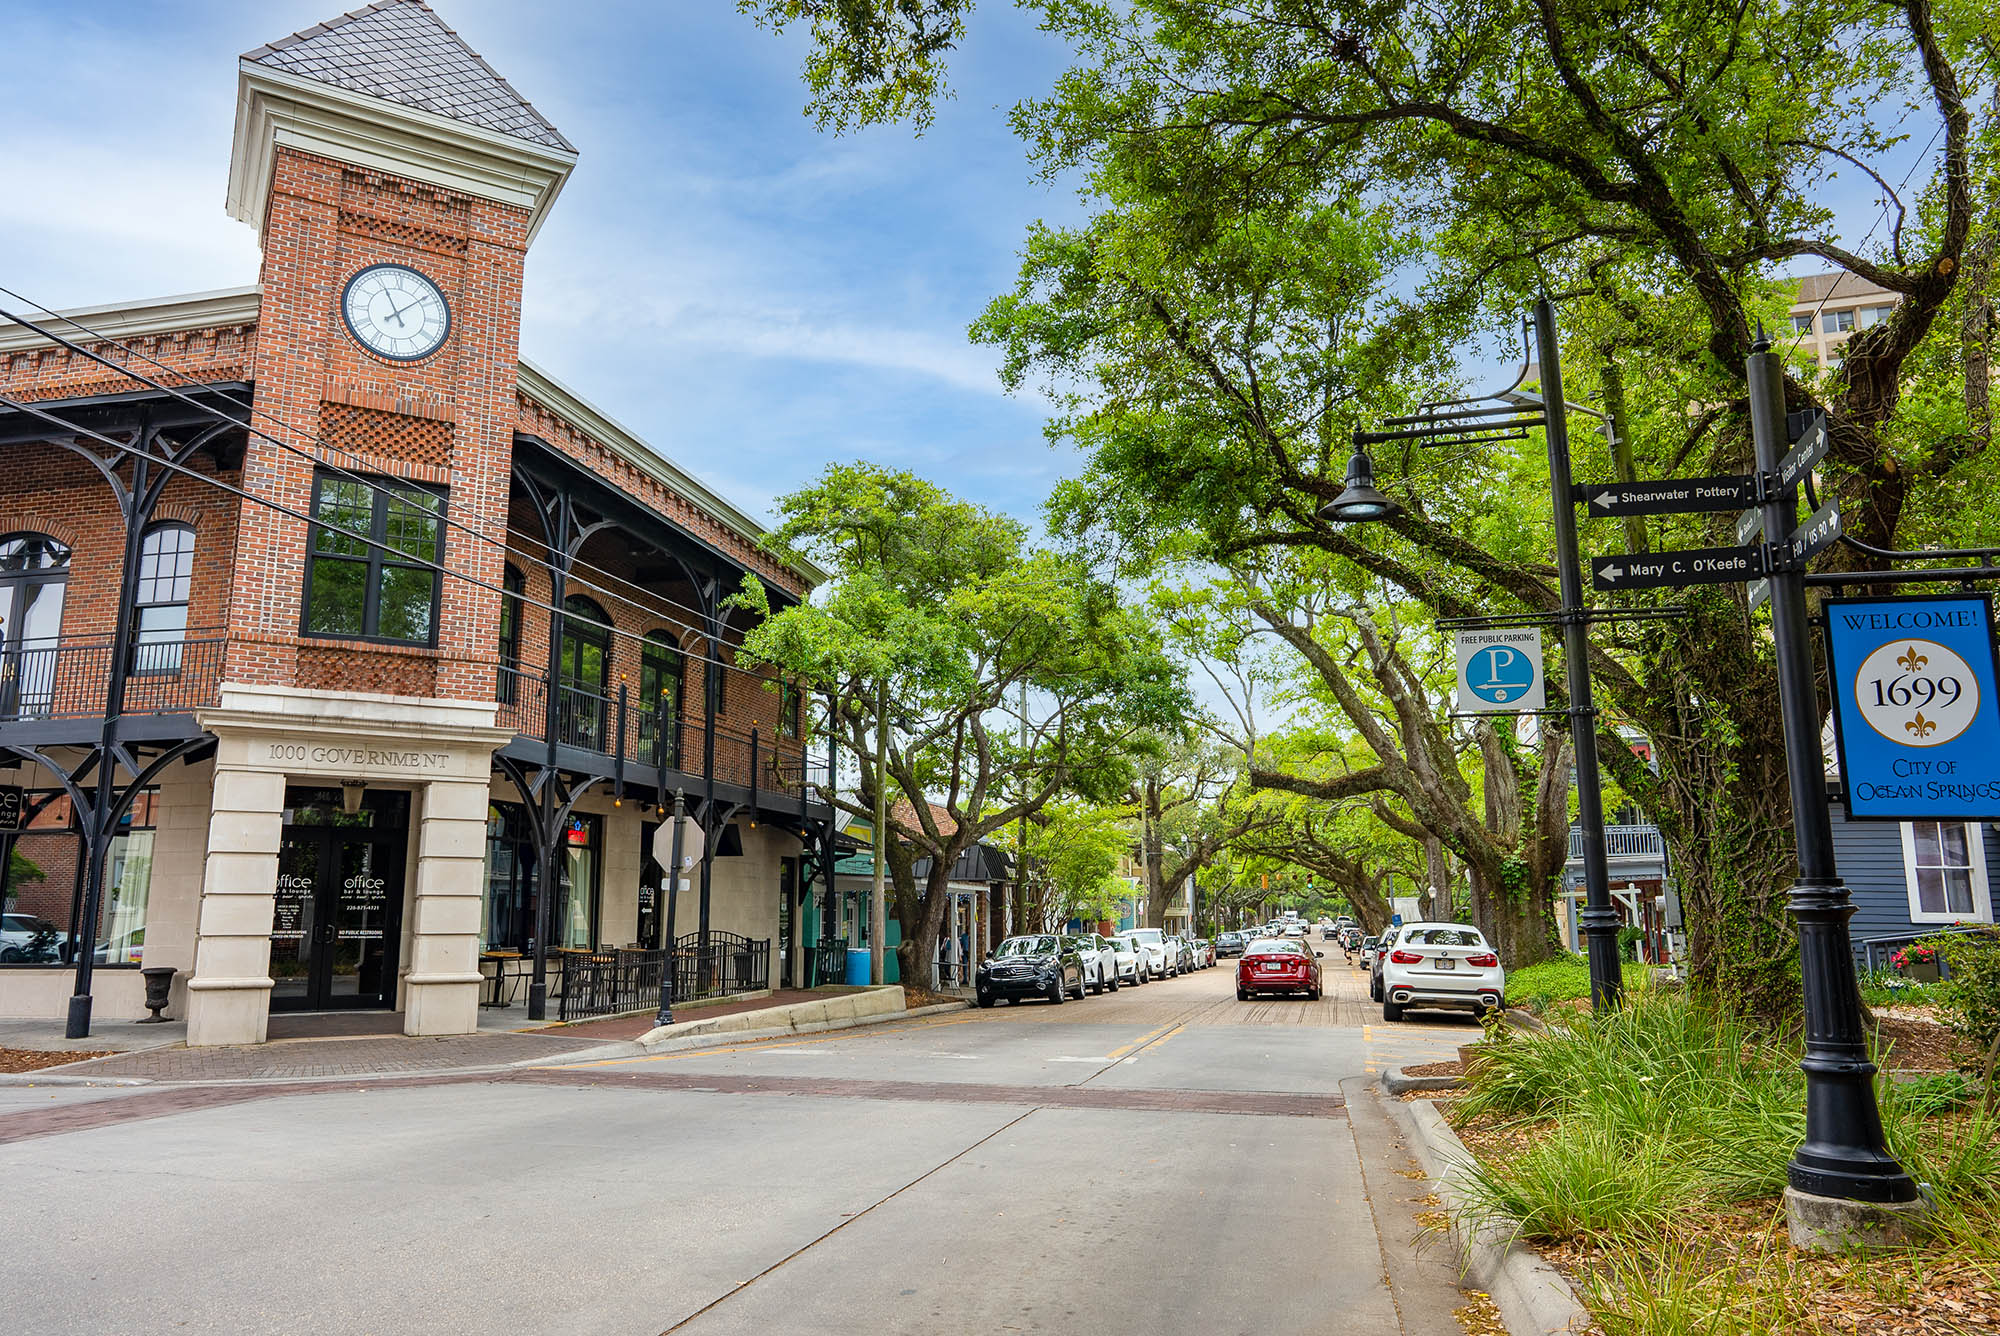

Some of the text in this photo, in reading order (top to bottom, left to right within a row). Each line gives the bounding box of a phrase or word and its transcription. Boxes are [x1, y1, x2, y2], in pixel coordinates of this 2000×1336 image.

[1781, 442, 1814, 485] Visitor Center
[1621, 487, 1739, 503] Shearwater Pottery
[1809, 528, 1818, 546] US
[1818, 521, 1828, 537] 90
[1630, 557, 1747, 577] Mary C. O'Keefe
[1843, 611, 1978, 630] WELCOME!
[1461, 632, 1535, 645] FREE PUBLIC PARKING
[1485, 649, 1514, 683] P
[1870, 674, 1961, 709] 1699
[269, 744, 450, 769] 1000 GOVERNMENT
[344, 875, 384, 888] office
